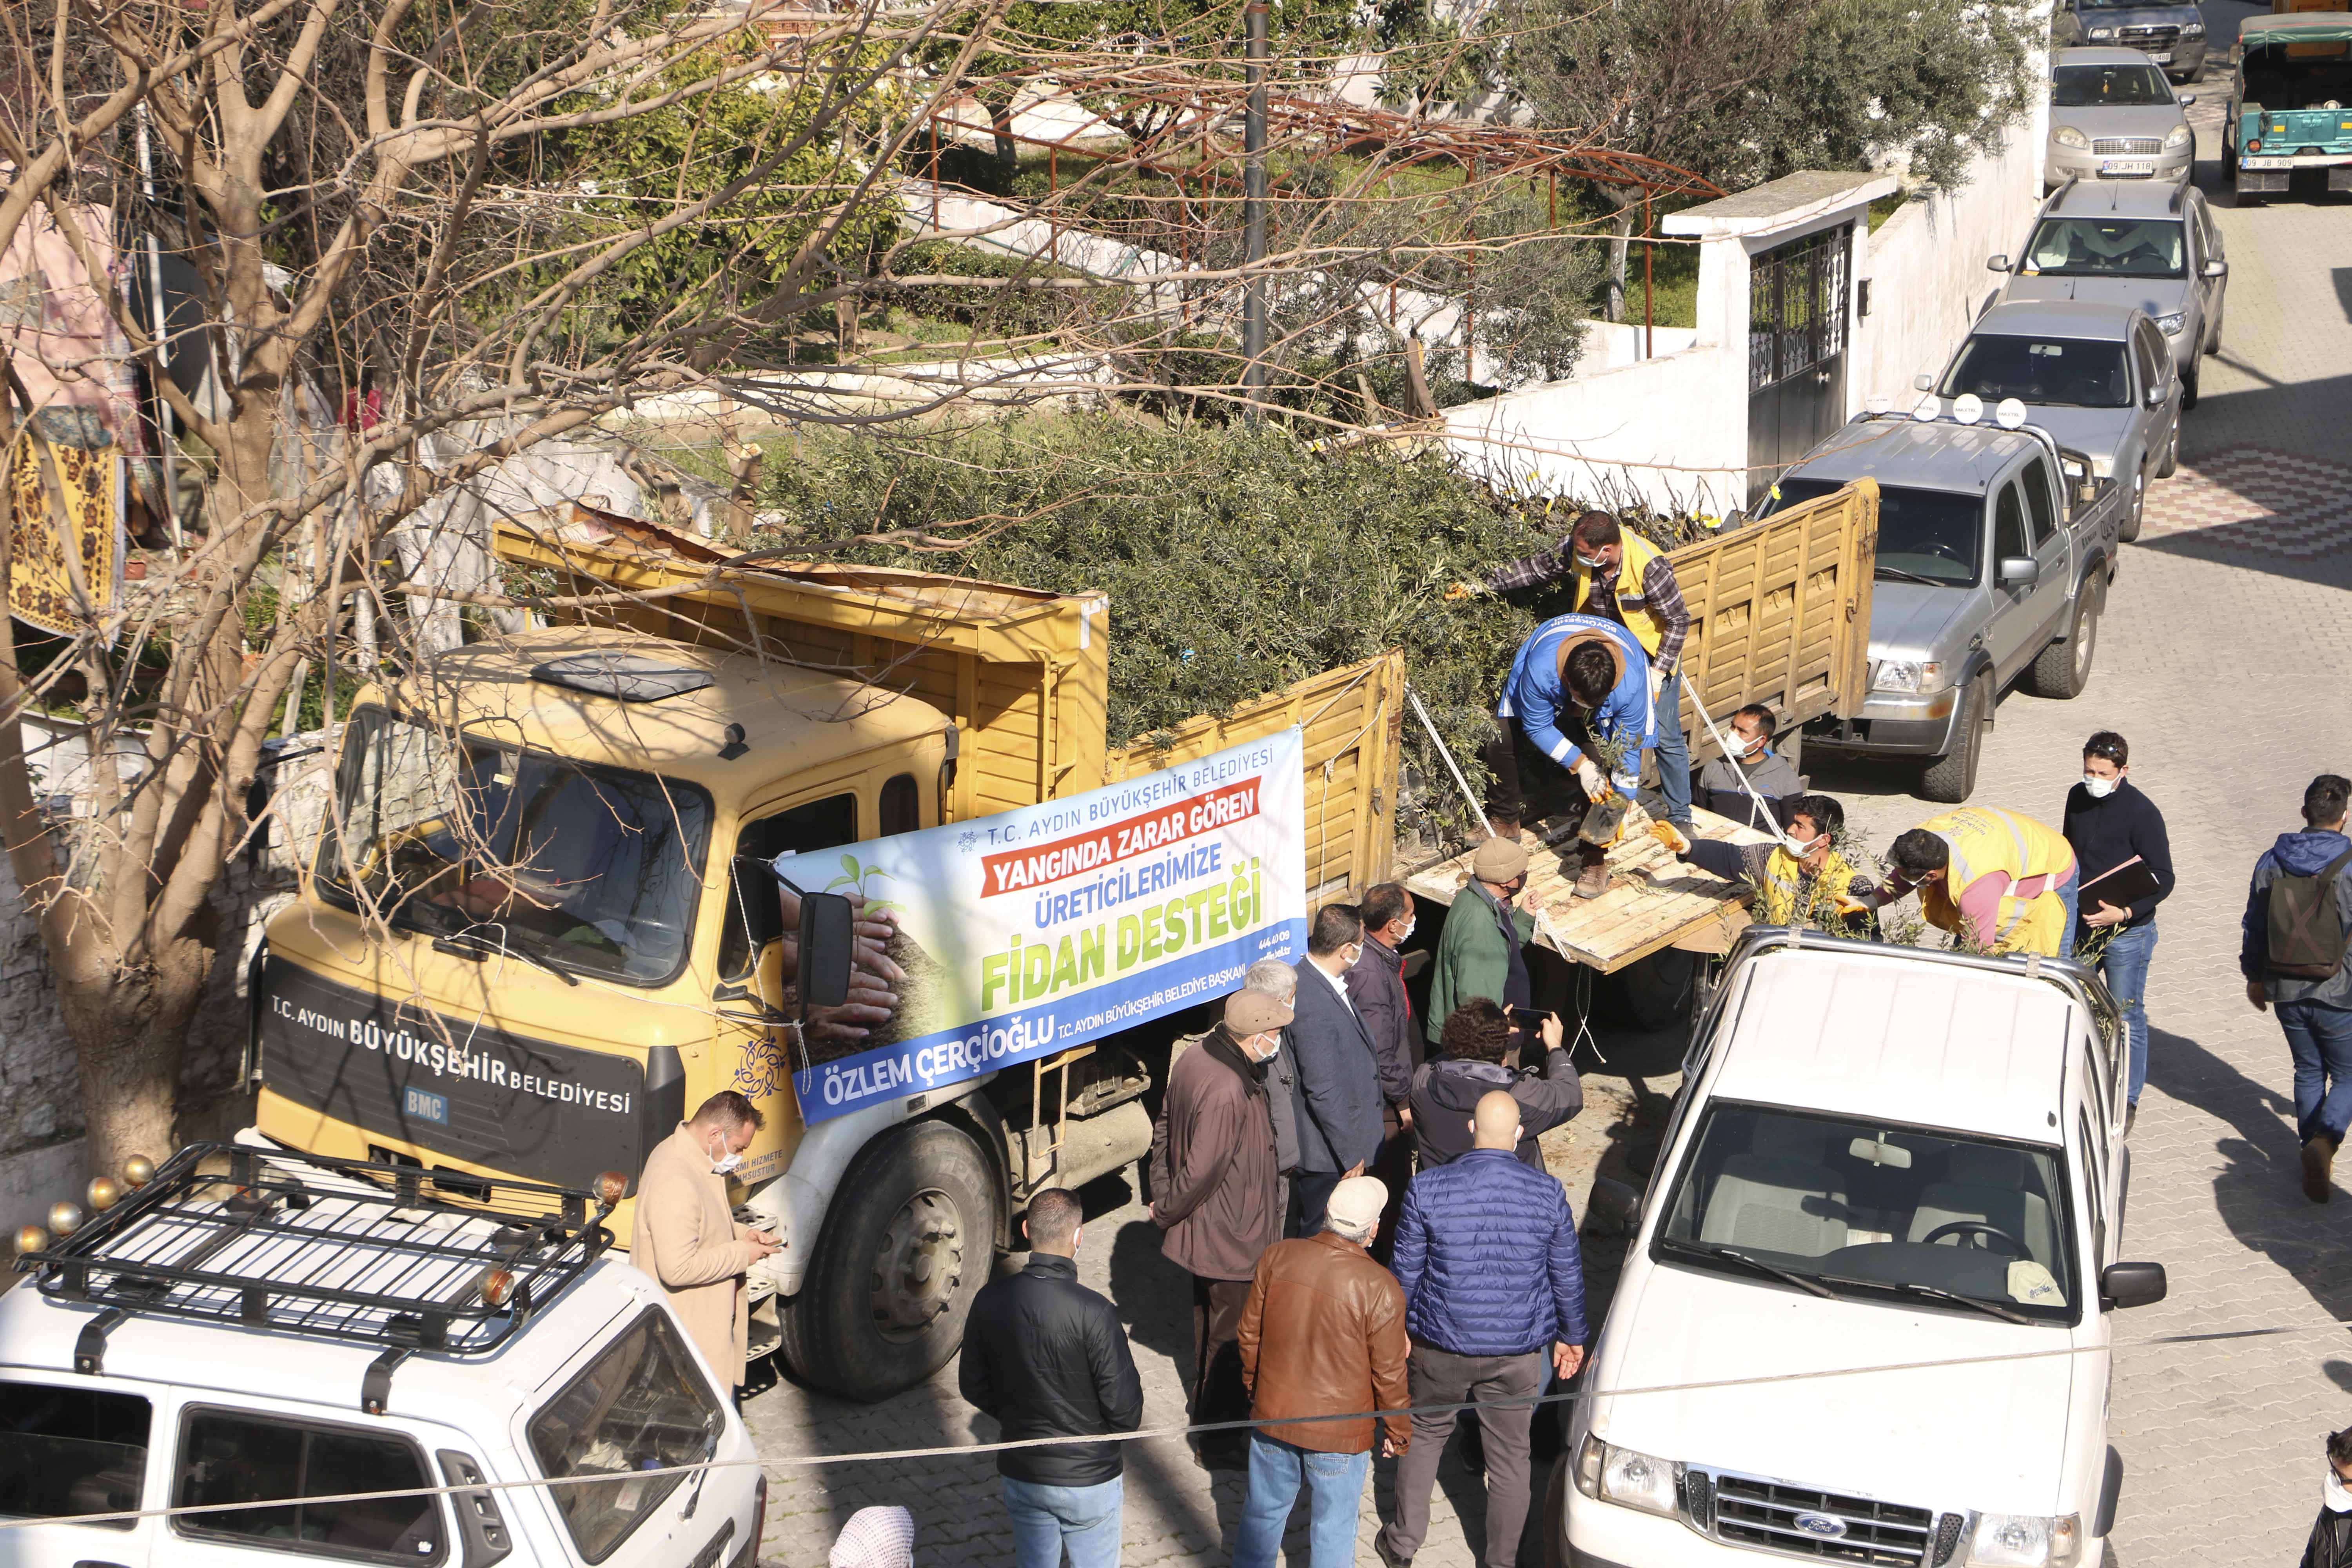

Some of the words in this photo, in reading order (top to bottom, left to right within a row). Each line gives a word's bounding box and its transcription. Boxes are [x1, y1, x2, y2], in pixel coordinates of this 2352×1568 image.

[987, 824, 1021, 846] T.C.
[1029, 809, 1081, 838] AYDIN
[1089, 774, 1186, 821] BÜYÜKŞEHİR
[1193, 744, 1273, 787] BELEDİYESİ
[993, 837, 1111, 891] YANGINDA
[1117, 809, 1185, 857] ZARAR
[1190, 788, 1253, 833] GÖREN
[1035, 842, 1222, 929] ÜRETİCİLERİMİZE
[981, 923, 1105, 1012] FİDAN
[1117, 856, 1260, 971] DESTEĞİ
[1258, 937, 1271, 950] 444
[1272, 933, 1279, 945] 40
[1279, 930, 1290, 942] 09
[1058, 1022, 1074, 1039] T.C.
[1074, 1013, 1104, 1034] AYDIN
[1105, 990, 1165, 1021] BÜYÜKŞEHİR
[1165, 977, 1207, 1004] BELEDİYE
[1208, 963, 1247, 989] BAŞKANI
[272, 995, 295, 1020] T.C.
[297, 1007, 345, 1039] AYDIN
[349, 1018, 506, 1087] BÜYÜKŞEHİR
[510, 1071, 631, 1114] BELEDİYESİ
[823, 1054, 912, 1105] ÖZLEM
[915, 1015, 1054, 1088] ÇERÇİOĞLU
[408, 1090, 442, 1121] BMC
[731, 1163, 775, 1185] MAHSUSTUR
[751, 1149, 783, 1167] HİZMETE
[1808, 1520, 1833, 1532] Ford
